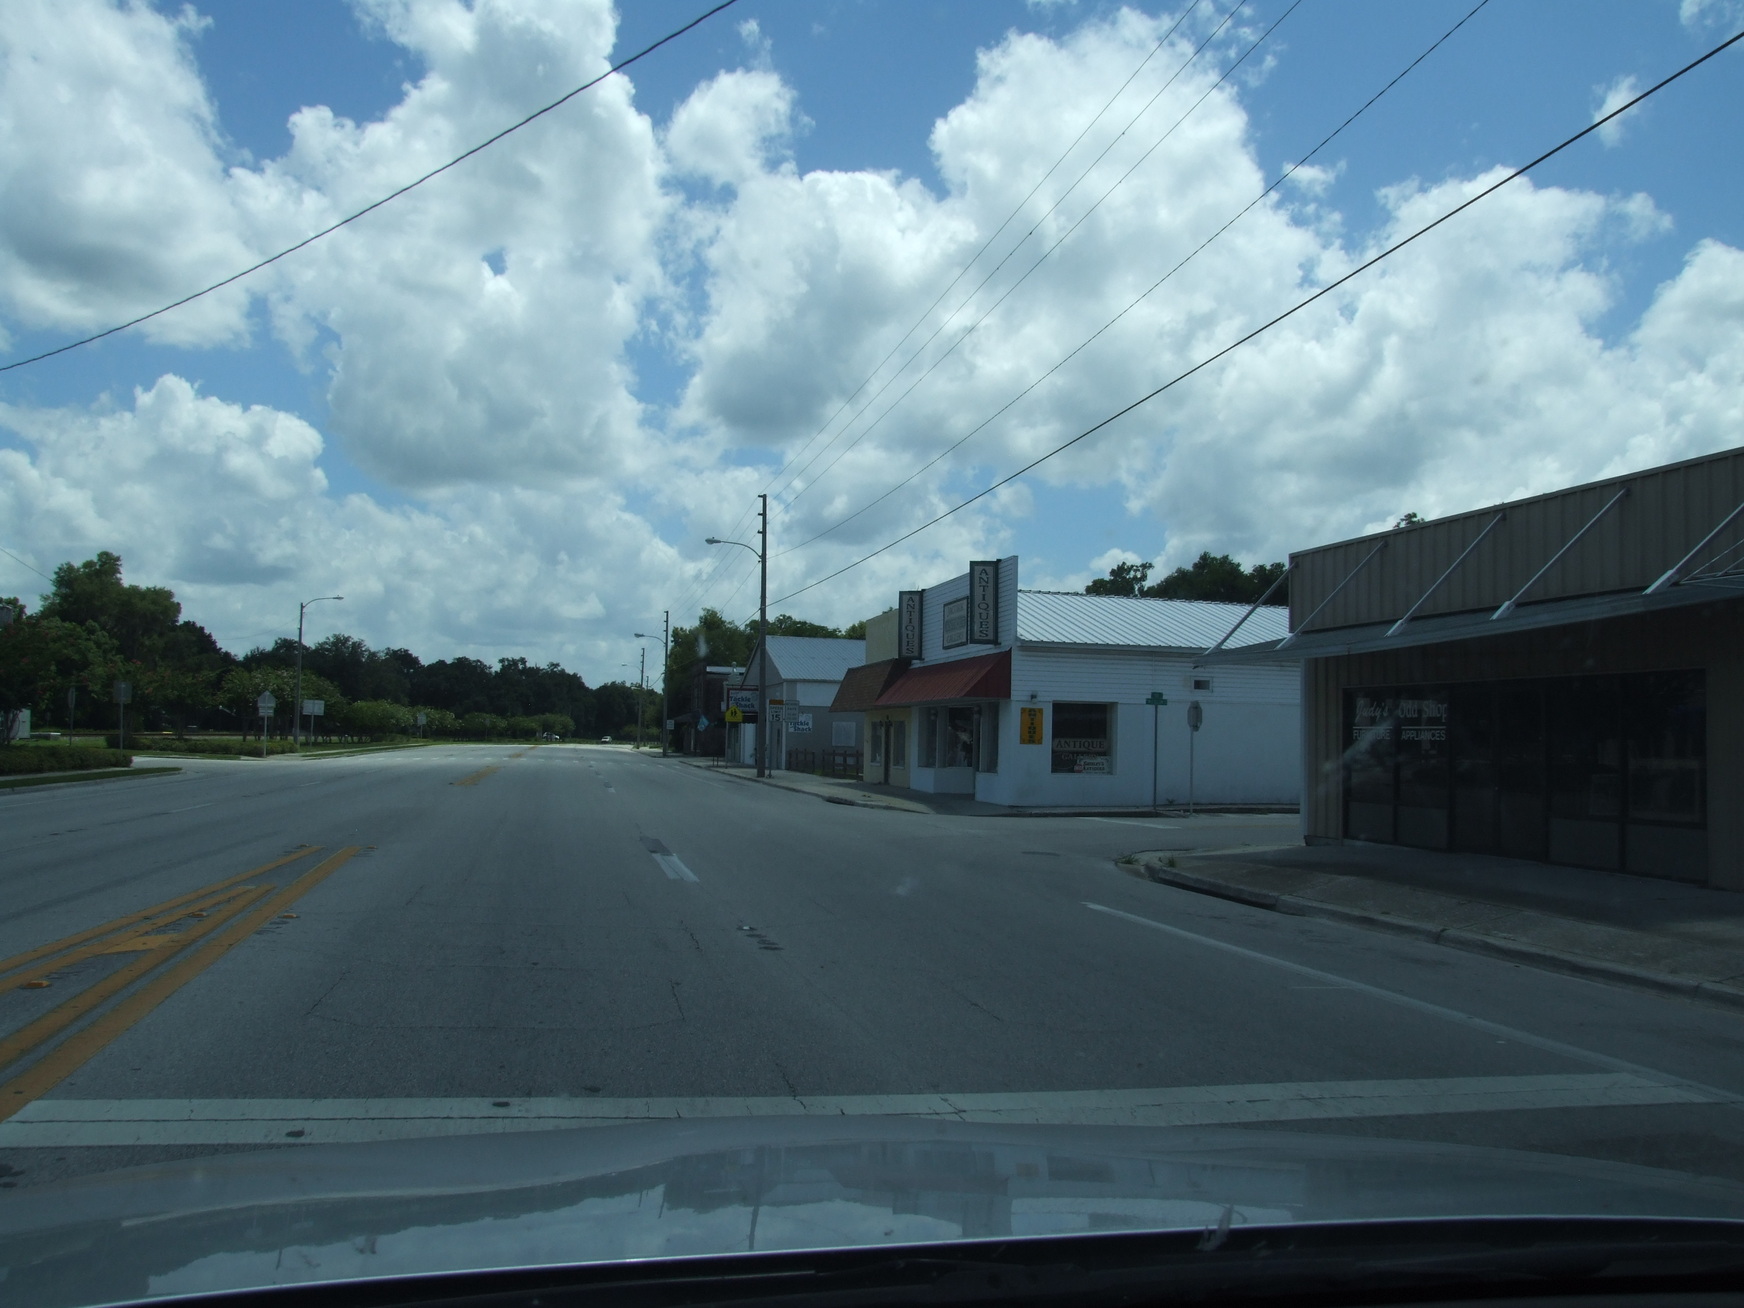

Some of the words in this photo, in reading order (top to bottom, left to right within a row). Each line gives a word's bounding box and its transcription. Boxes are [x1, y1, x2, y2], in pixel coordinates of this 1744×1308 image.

[978, 568, 990, 638] ANTIQUES
[905, 596, 916, 655] ANTIQUES
[771, 714, 781, 722] 15
[1355, 700, 1389, 723] Judy's
[1399, 701, 1418, 718] Odd
[1423, 700, 1447, 722] Shop
[1353, 730, 1391, 740] FURTURE
[1401, 730, 1446, 741] APPLIANCES
[1056, 740, 1105, 750] ANTIQUE
